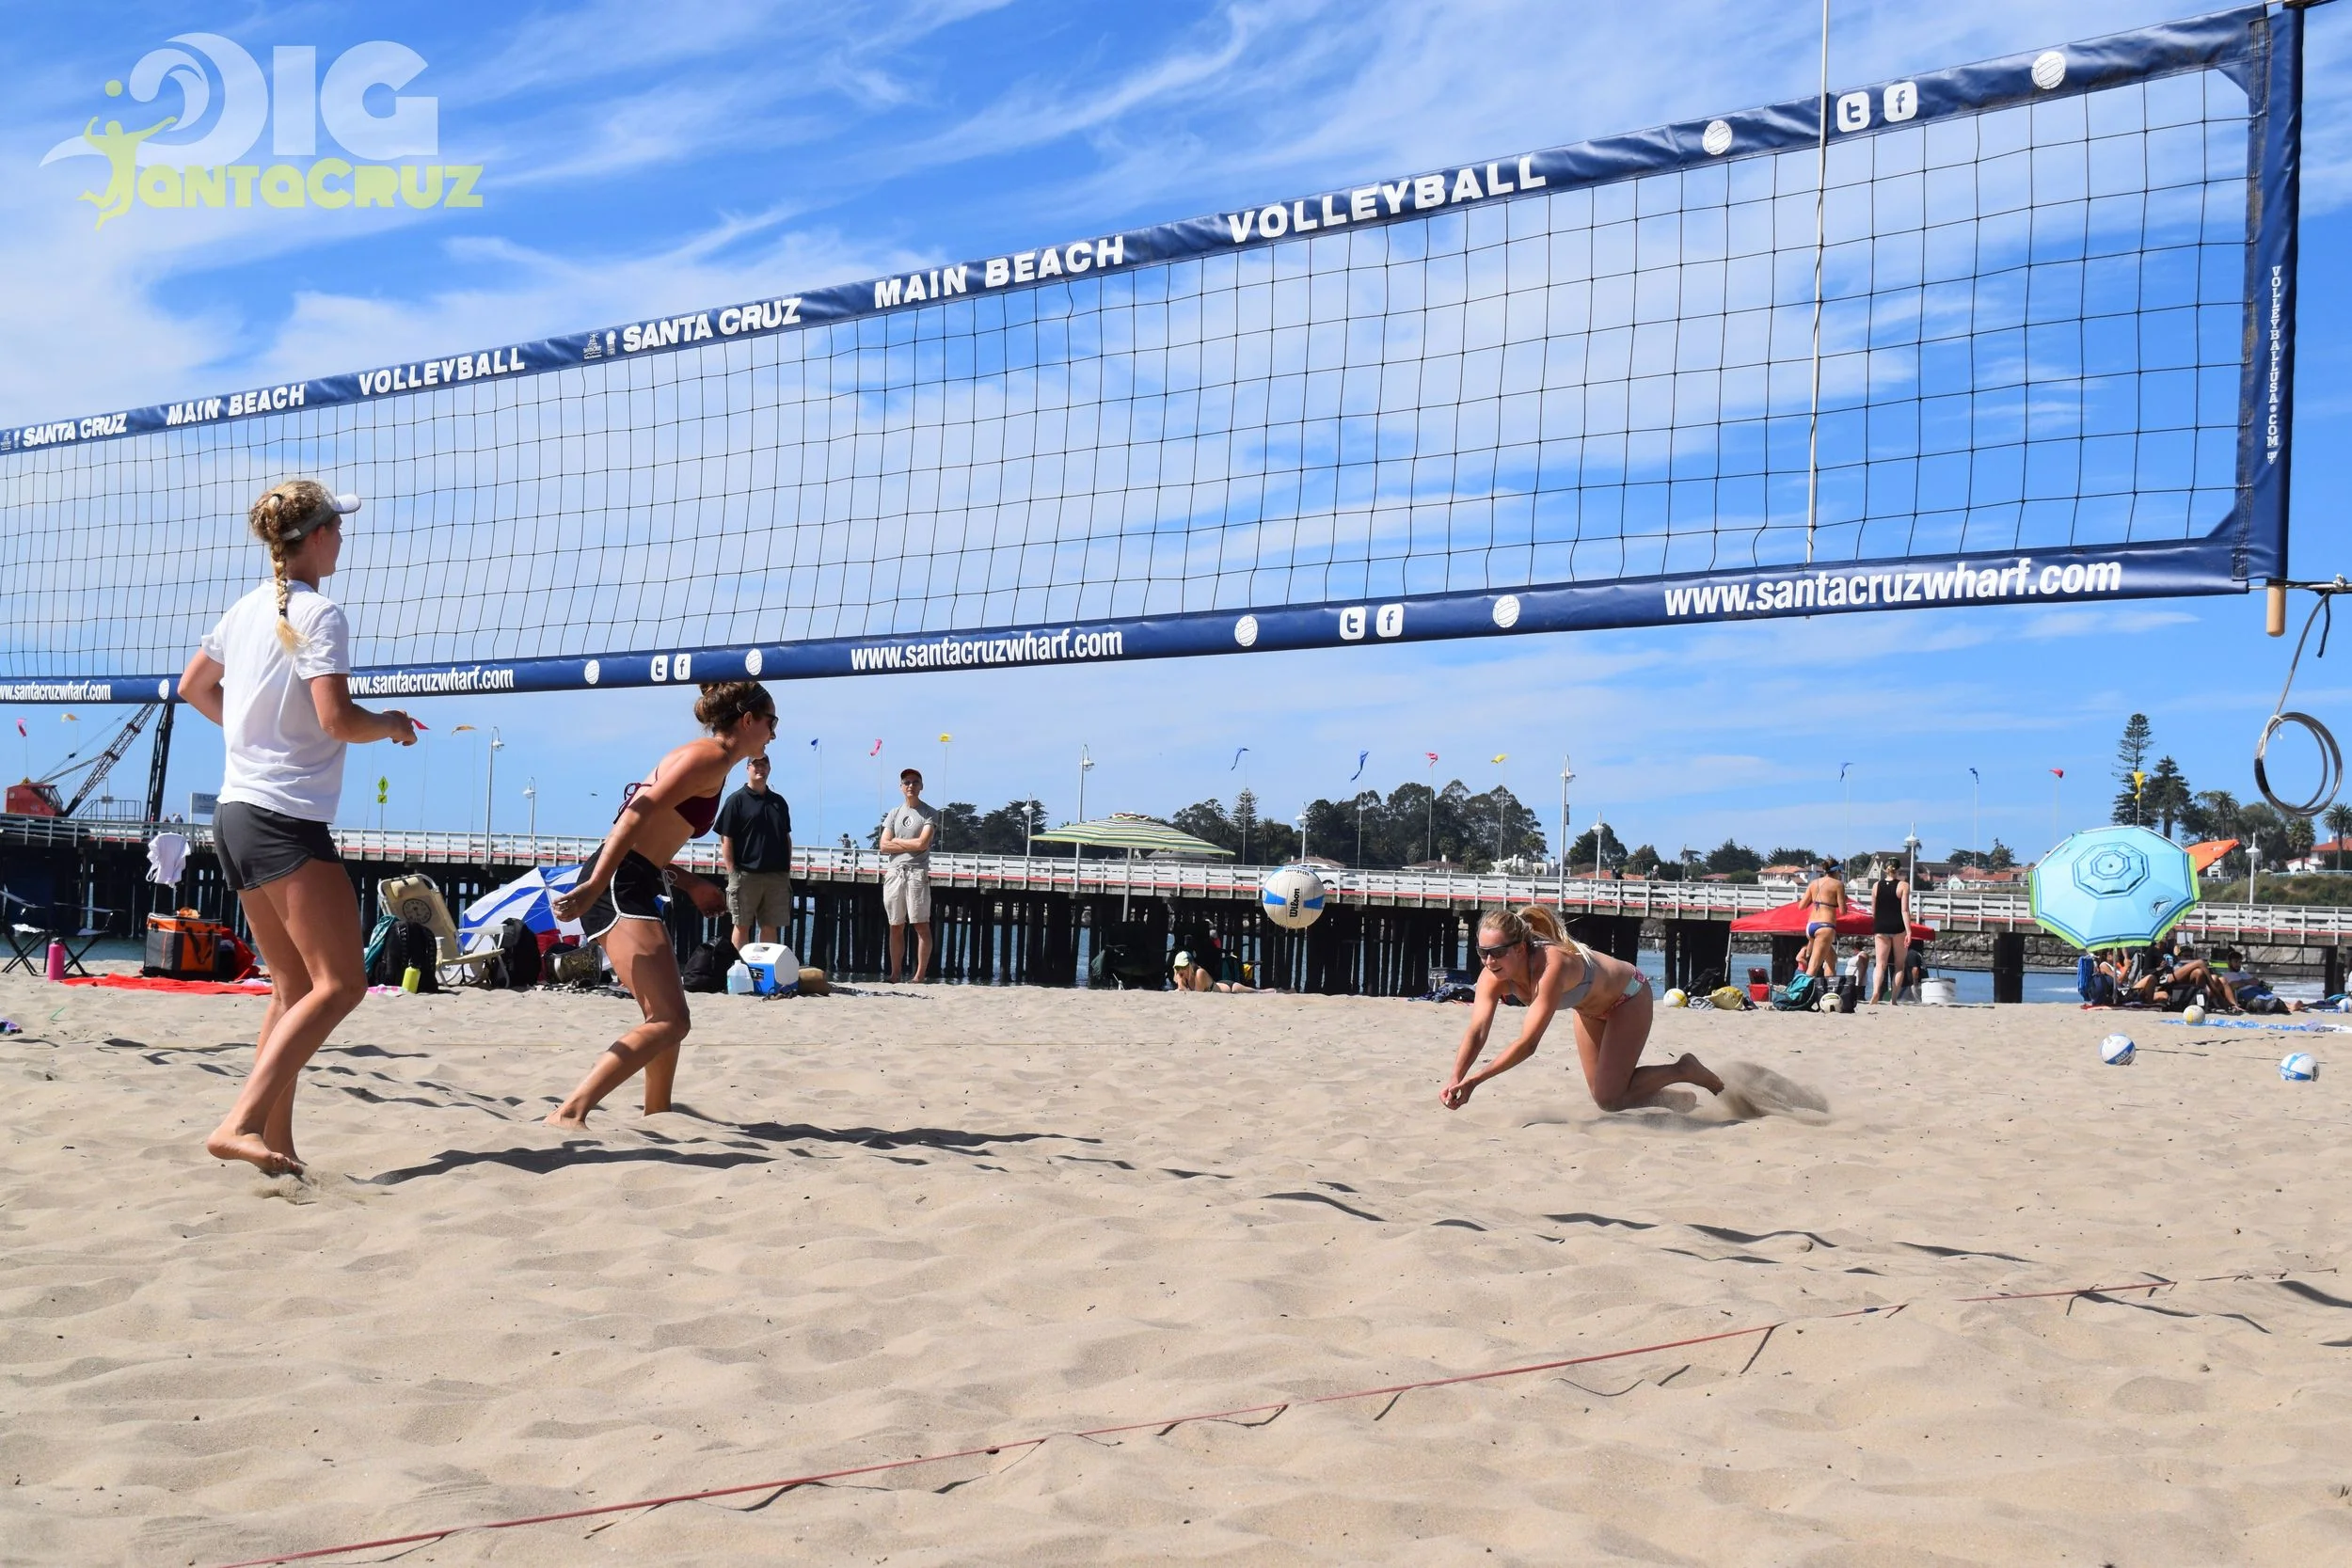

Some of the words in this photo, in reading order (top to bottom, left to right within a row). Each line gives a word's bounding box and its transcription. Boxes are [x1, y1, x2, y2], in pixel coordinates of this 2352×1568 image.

[623, 313, 710, 353] SANTA
[719, 297, 803, 336] CRUZ
[874, 265, 968, 309] MAIN
[984, 235, 1124, 289] BEACH
[1227, 157, 1547, 244] VOLLEYBALL
[23, 420, 77, 449] SANTA
[80, 413, 128, 438] CRUZ
[166, 396, 222, 426] MAIN
[228, 383, 307, 417] BEACH
[358, 347, 526, 396] VOLLEYBALL
[1664, 557, 2122, 617] www.santacruzwharf.com
[850, 627, 1123, 671] www.santacruzwharf.com
[0, 680, 111, 701] ww.santacruzwharf.com
[346, 665, 514, 695] ww.santacruzwharf.com
[1289, 888, 1300, 918] Wilson
